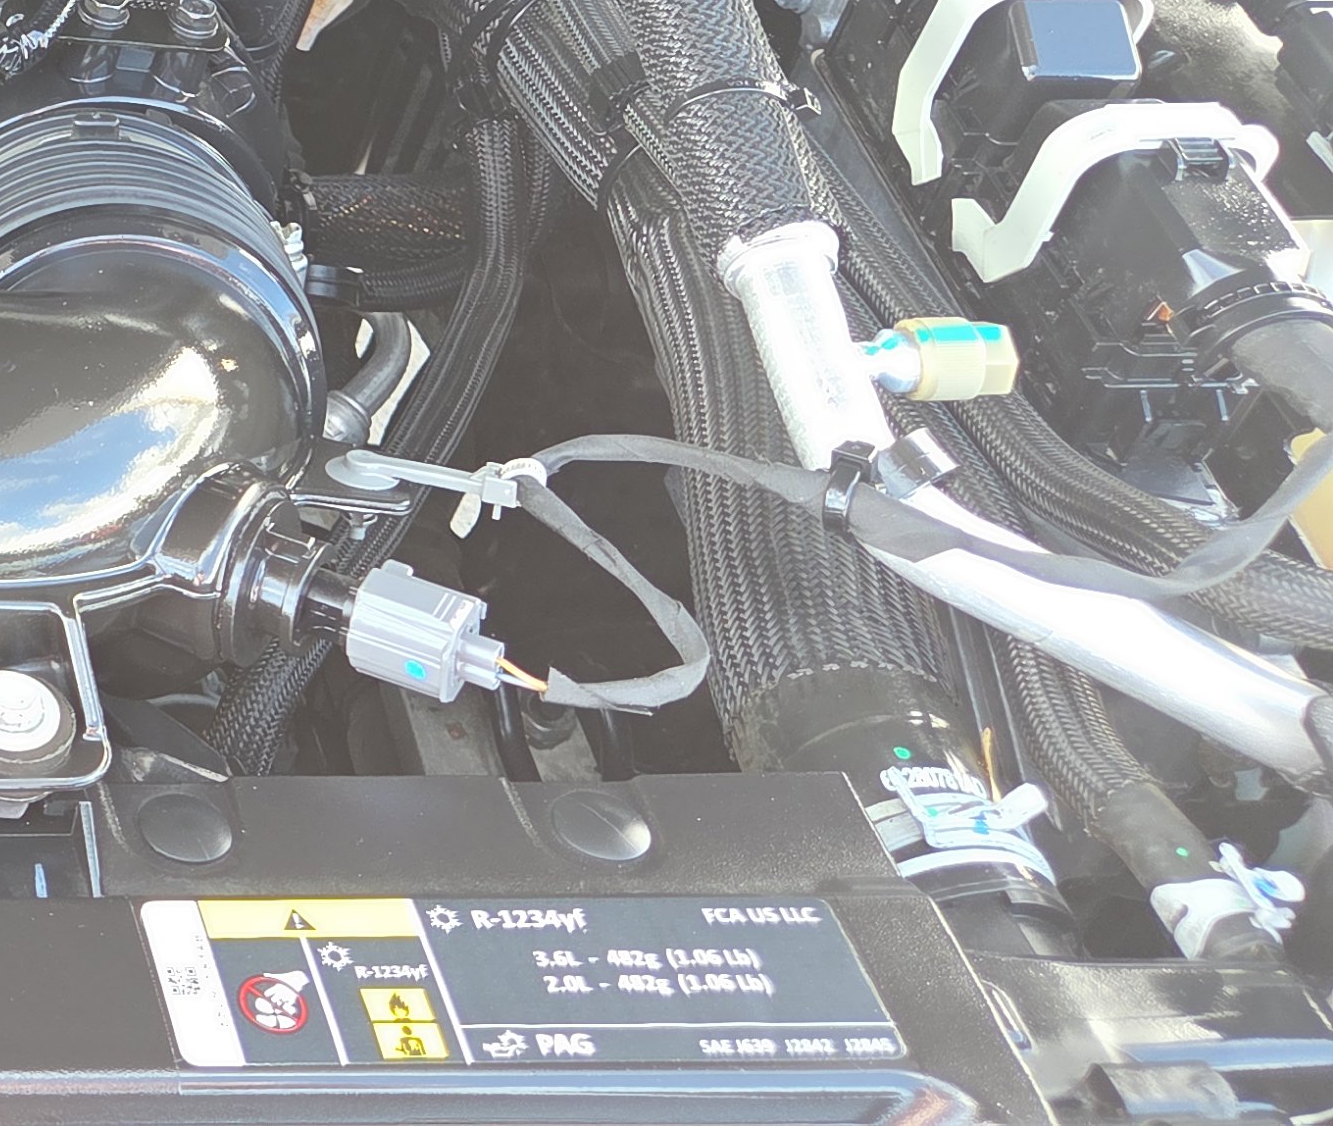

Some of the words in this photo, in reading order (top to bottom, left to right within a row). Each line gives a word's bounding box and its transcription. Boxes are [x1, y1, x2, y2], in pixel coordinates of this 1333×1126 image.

[470, 908, 587, 933] R-1234yf
[701, 907, 747, 926] FCA
[749, 907, 781, 925] US
[782, 907, 823, 924] LLC
[533, 950, 581, 968] 3.6L
[354, 964, 429, 981] R-1234yf
[543, 975, 593, 995] 2.0L
[536, 1033, 597, 1057] PAG
[699, 1039, 733, 1055] SAE
